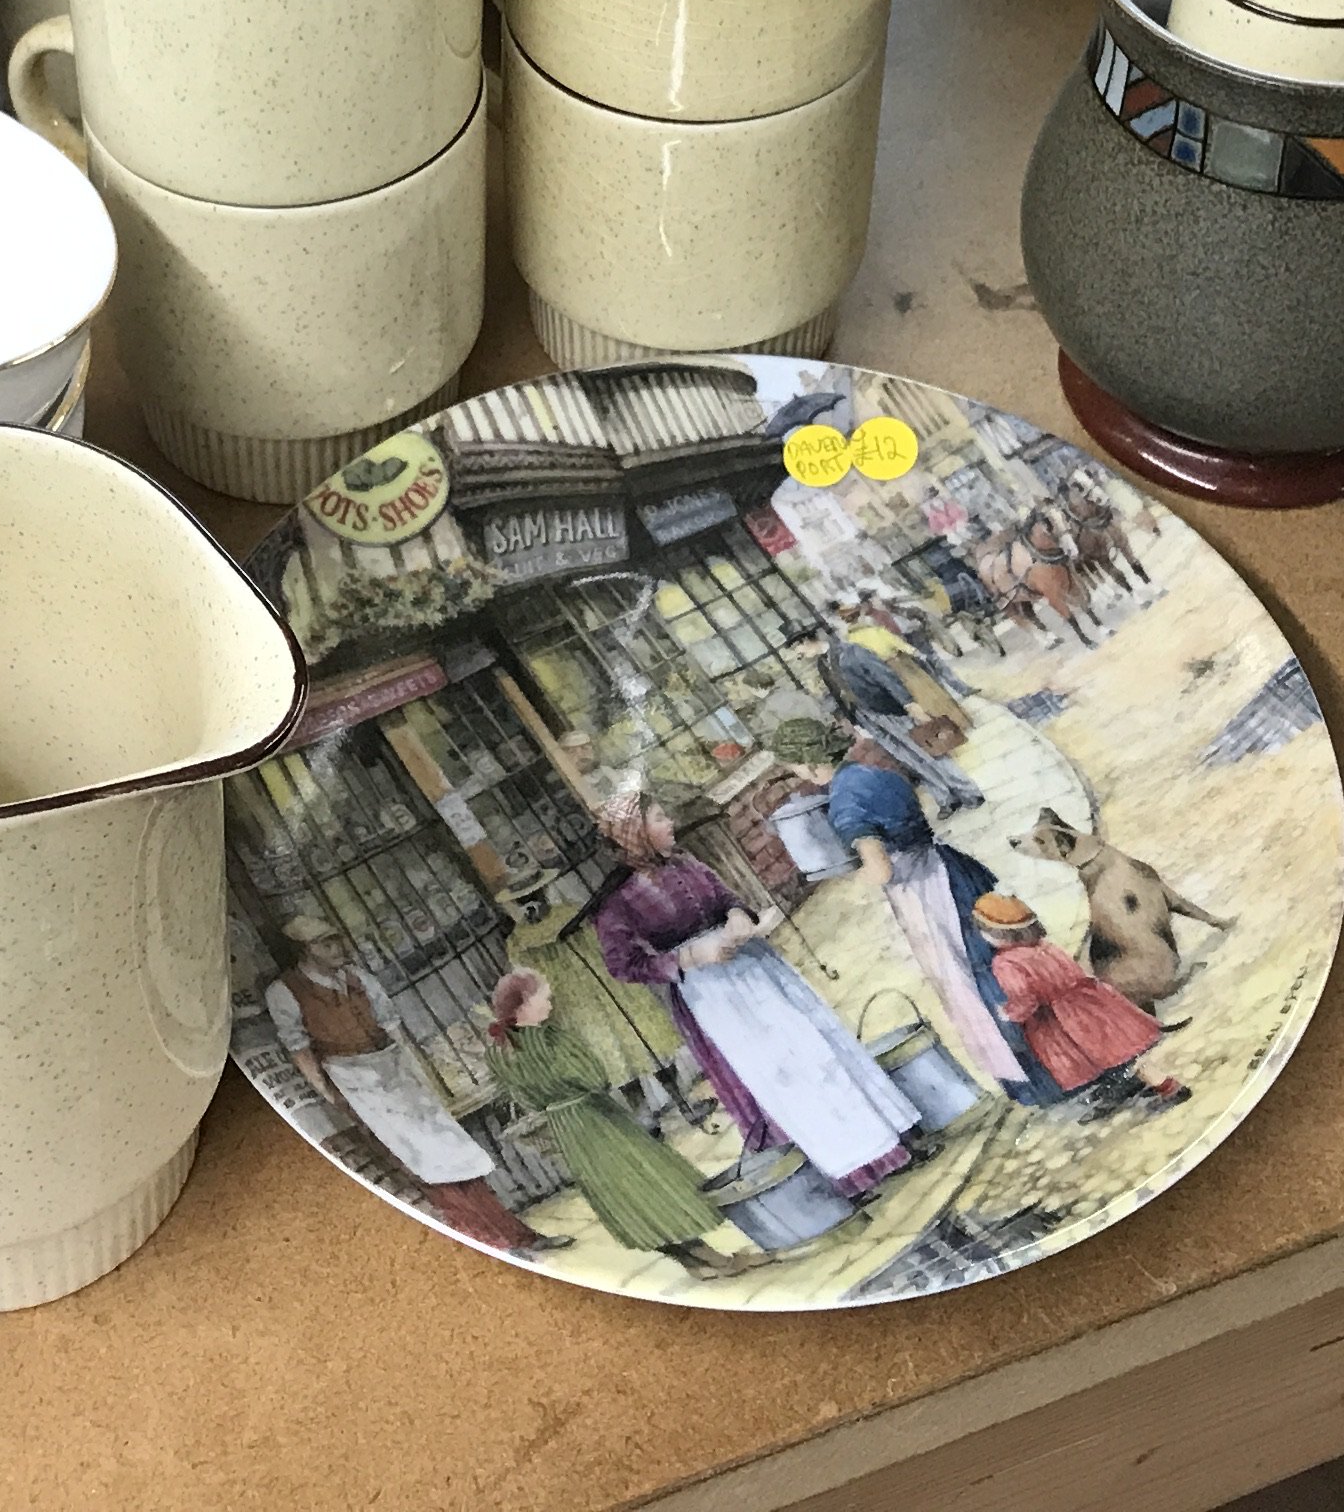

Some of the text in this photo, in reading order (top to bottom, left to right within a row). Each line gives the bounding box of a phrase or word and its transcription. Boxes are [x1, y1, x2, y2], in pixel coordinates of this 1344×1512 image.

[795, 452, 844, 479] PORT
[851, 428, 908, 467] £12
[316, 462, 443, 532] OTS SHOES
[491, 510, 547, 554] SAM
[553, 506, 621, 543] HALL
[555, 551, 569, 567] &
[578, 545, 618, 564] VEG
